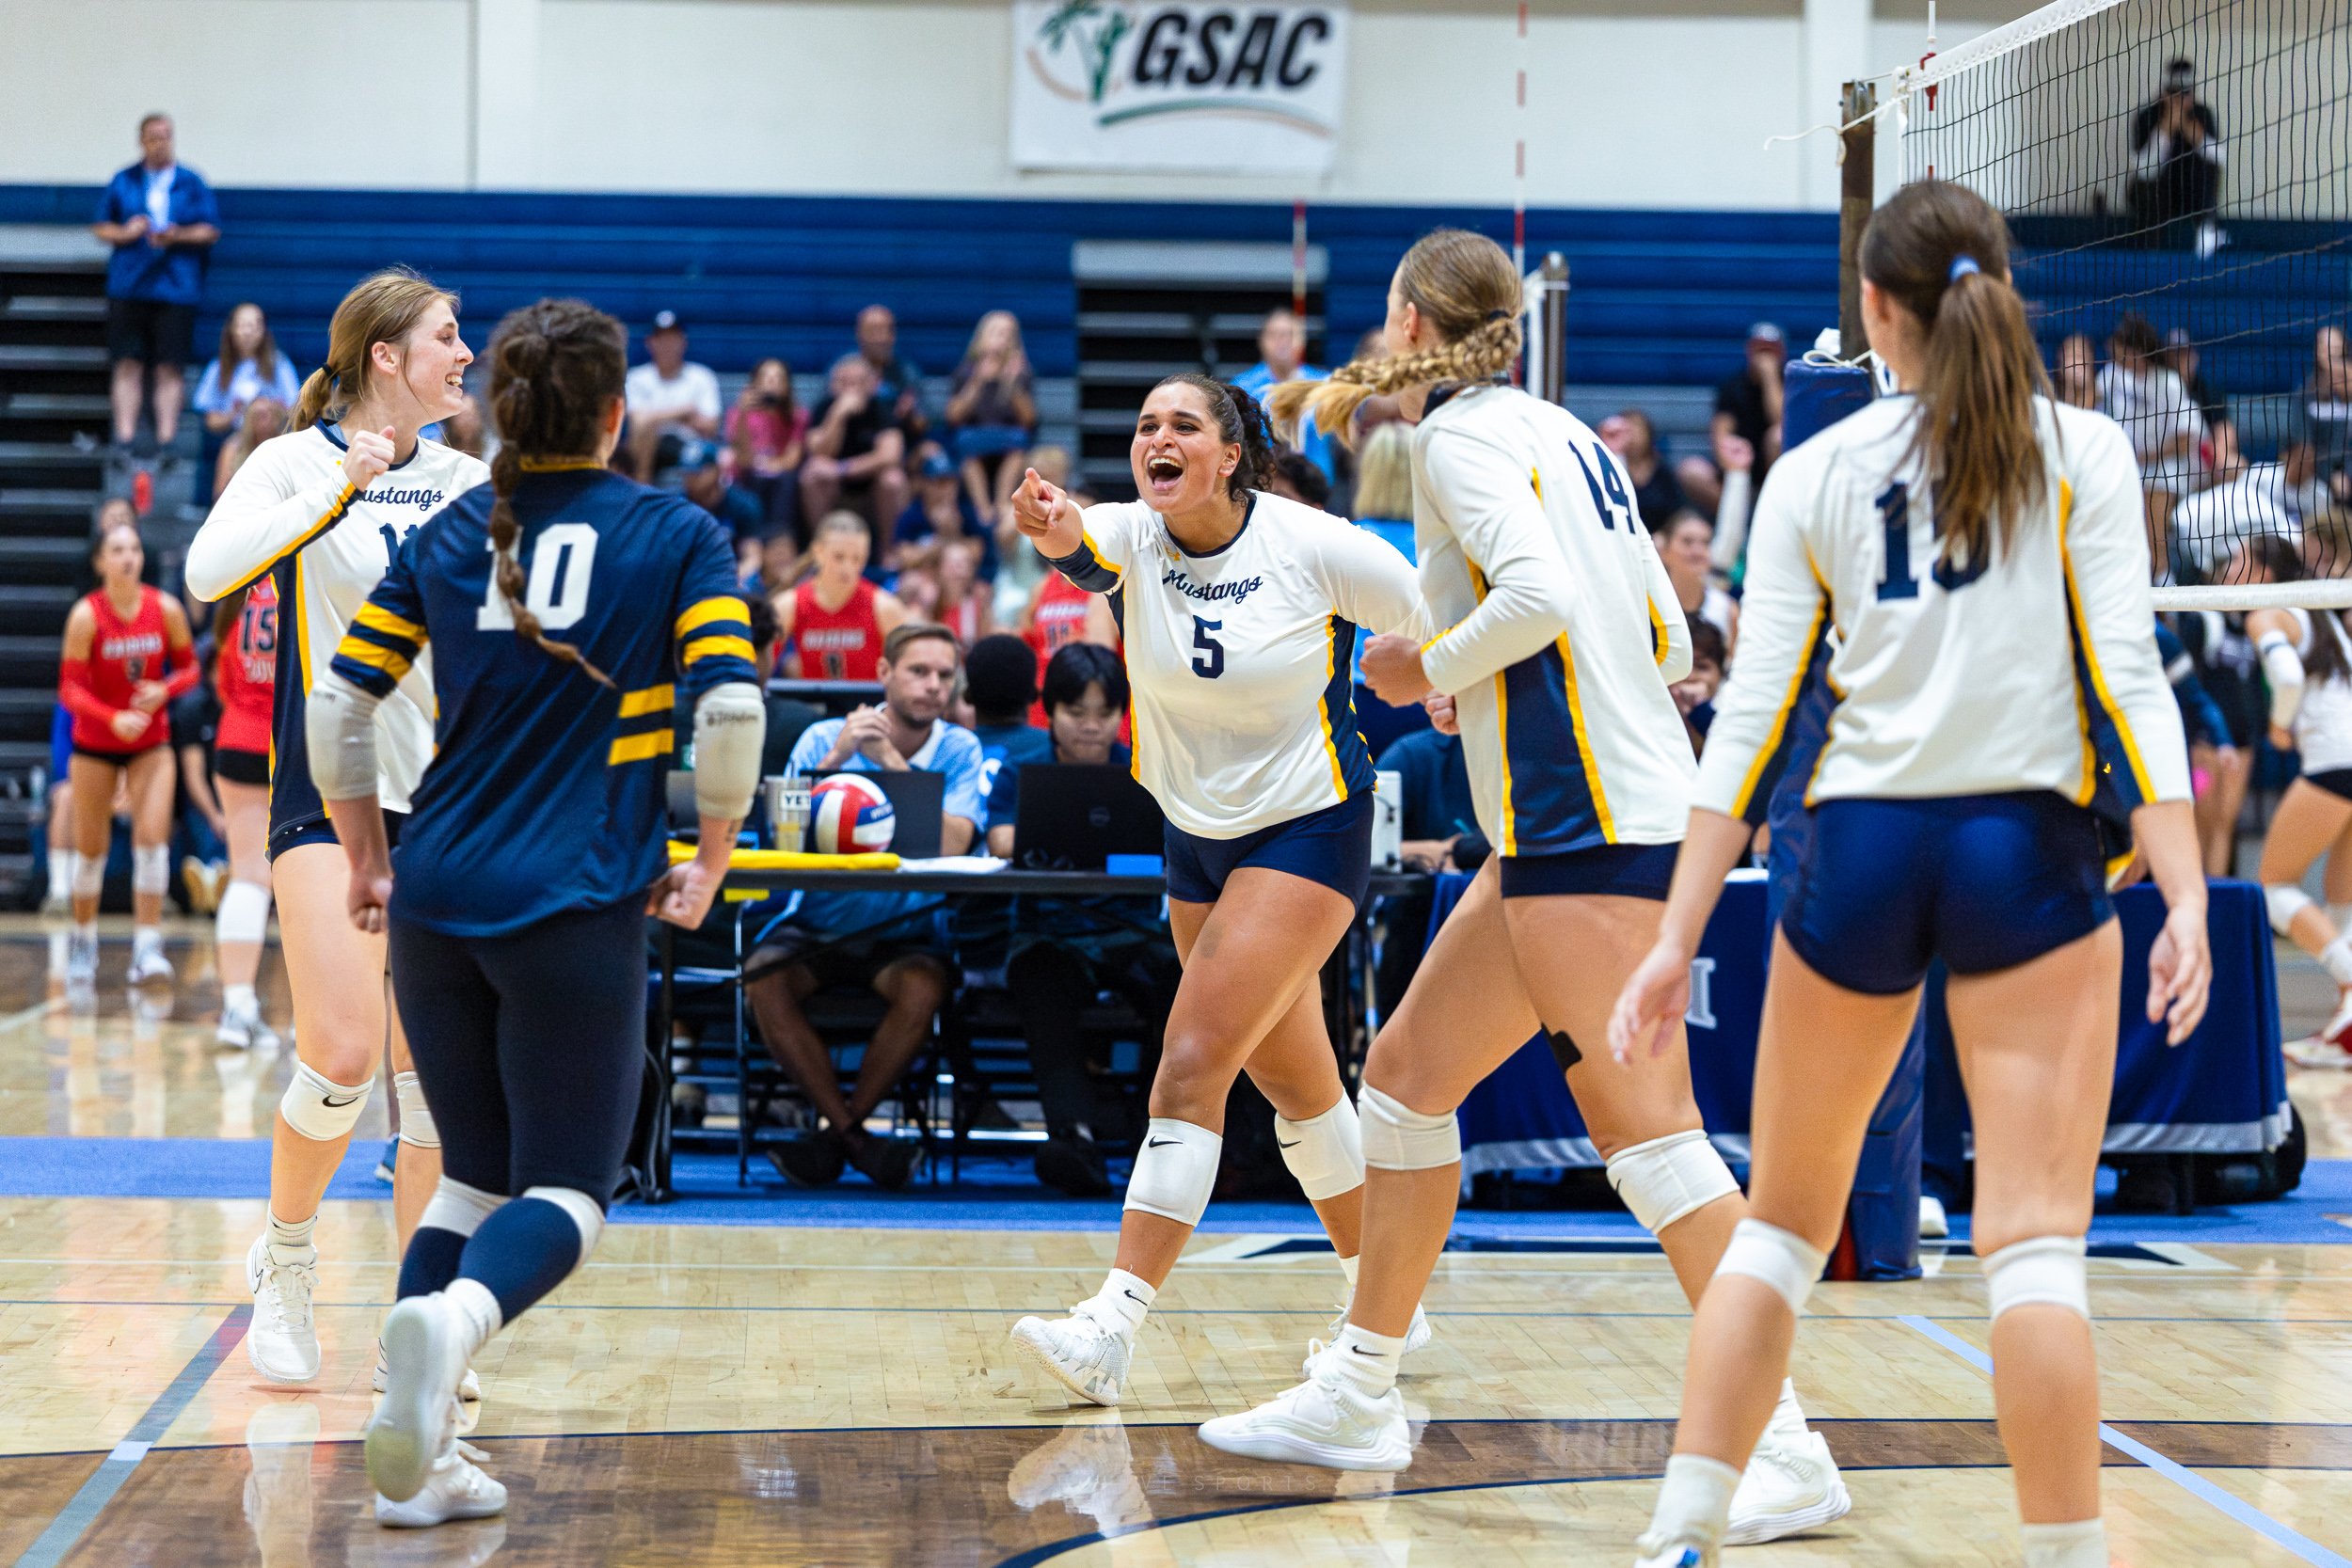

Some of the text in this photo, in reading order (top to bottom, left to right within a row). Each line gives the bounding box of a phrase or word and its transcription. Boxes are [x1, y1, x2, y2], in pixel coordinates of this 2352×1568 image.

[1134, 12, 1330, 89] GSAC
[360, 486, 444, 512] ustangs
[1567, 439, 1636, 535] 14
[476, 522, 598, 631] 10
[1162, 569, 1263, 604] Mustangs
[1192, 614, 1225, 679] 5
